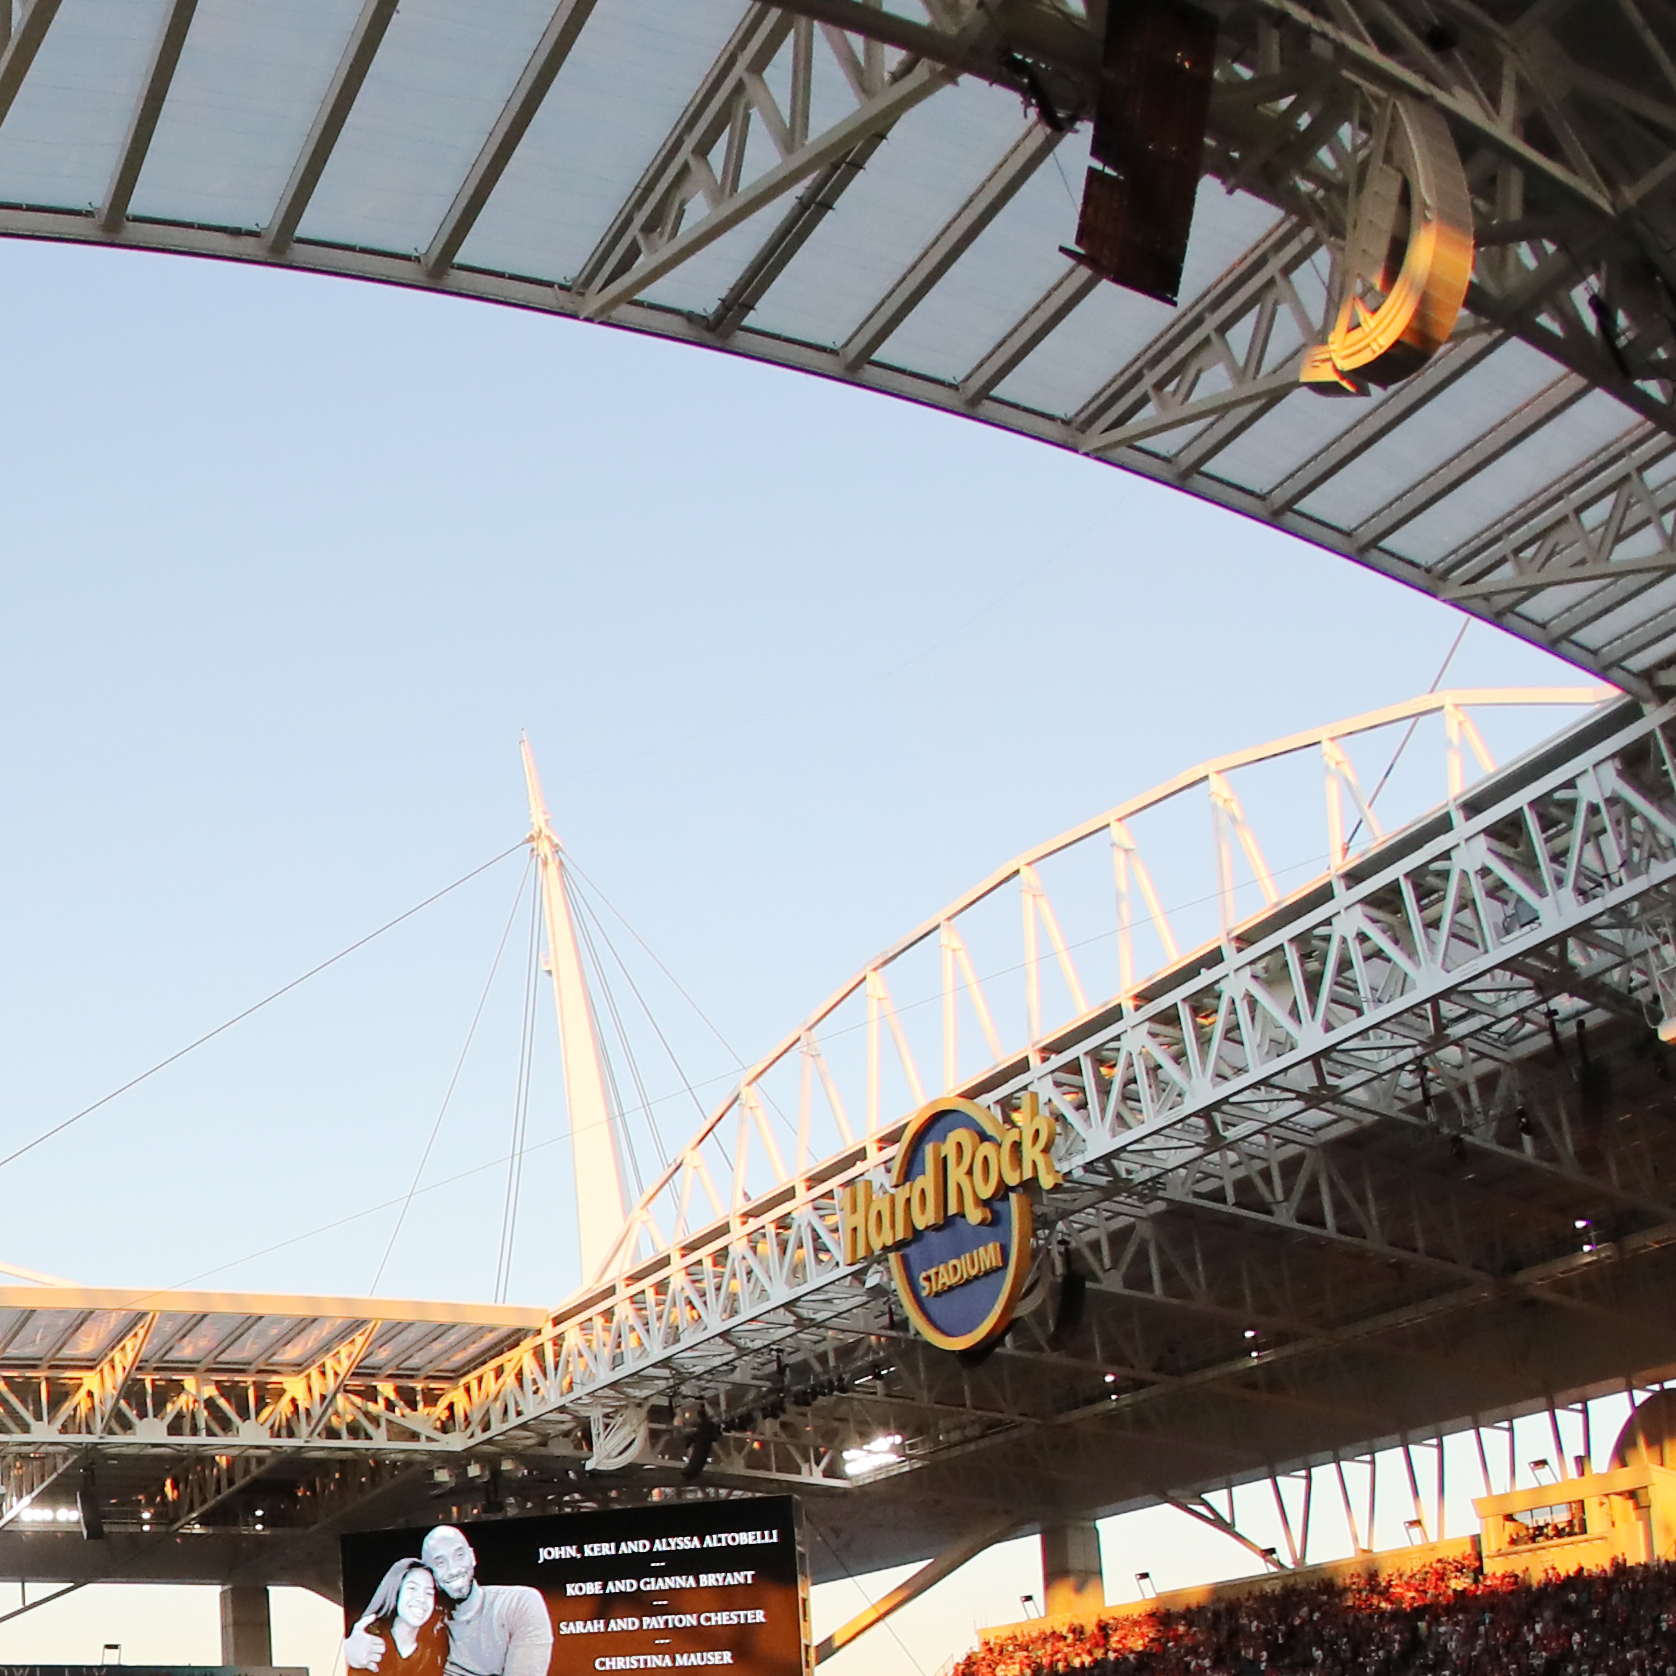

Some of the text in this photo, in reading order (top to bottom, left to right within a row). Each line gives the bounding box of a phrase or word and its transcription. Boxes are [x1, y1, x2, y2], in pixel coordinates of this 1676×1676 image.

[841, 1091, 1064, 1265] Hard Rock
[919, 1241, 1004, 1298] STADIUM
[538, 1529, 779, 1563] JOHN, KERI AND ALYSSA ALTOBELLI
[566, 1570, 756, 1597] KOBE AND GIANNA BRYANT
[559, 1609, 767, 1635] SARAH AND PAYTON CHESTER
[594, 1650, 733, 1671] CHRISTINA MAUSER
